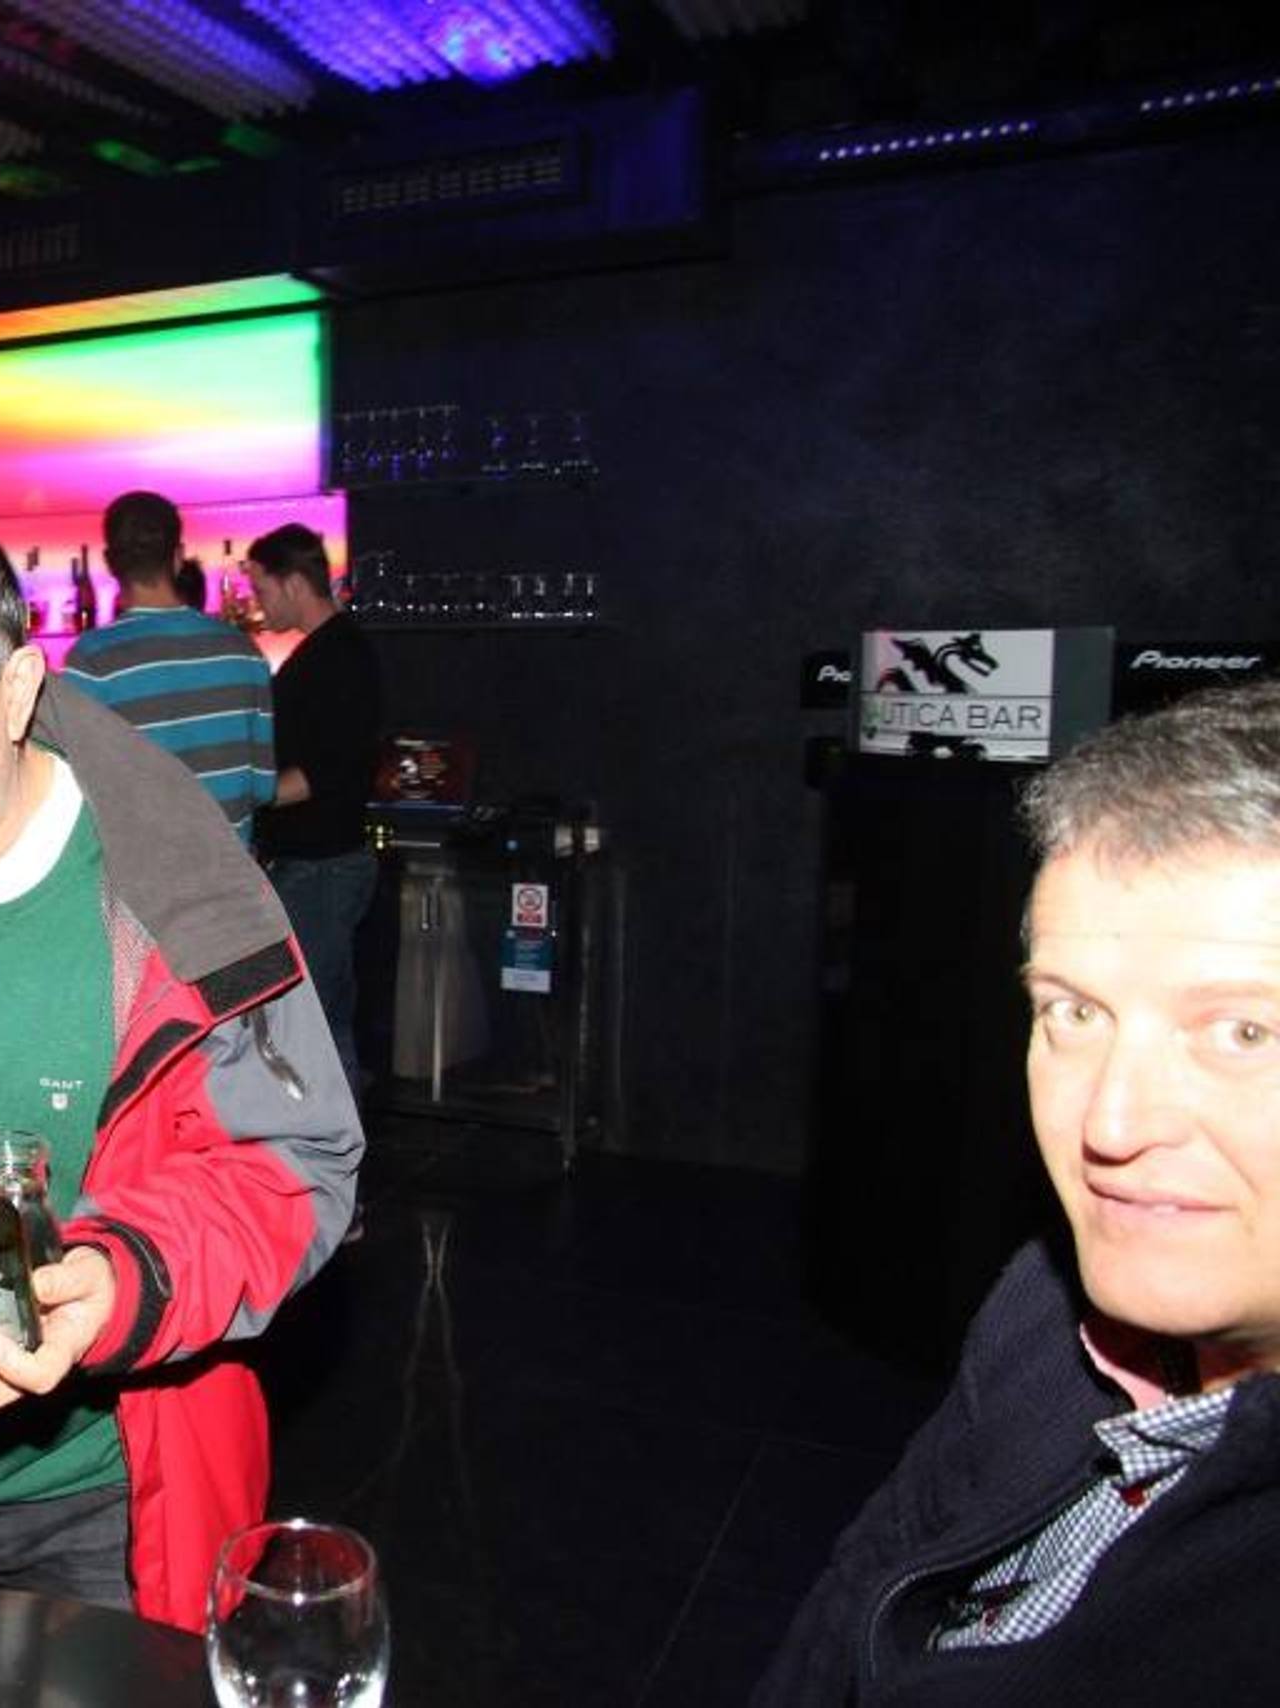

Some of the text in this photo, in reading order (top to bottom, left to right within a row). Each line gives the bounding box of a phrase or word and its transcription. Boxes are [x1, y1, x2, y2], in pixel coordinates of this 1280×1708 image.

[1130, 650, 1261, 669] Pioneer
[967, 704, 1042, 731] BAR
[39, 1077, 84, 1092] GANT
